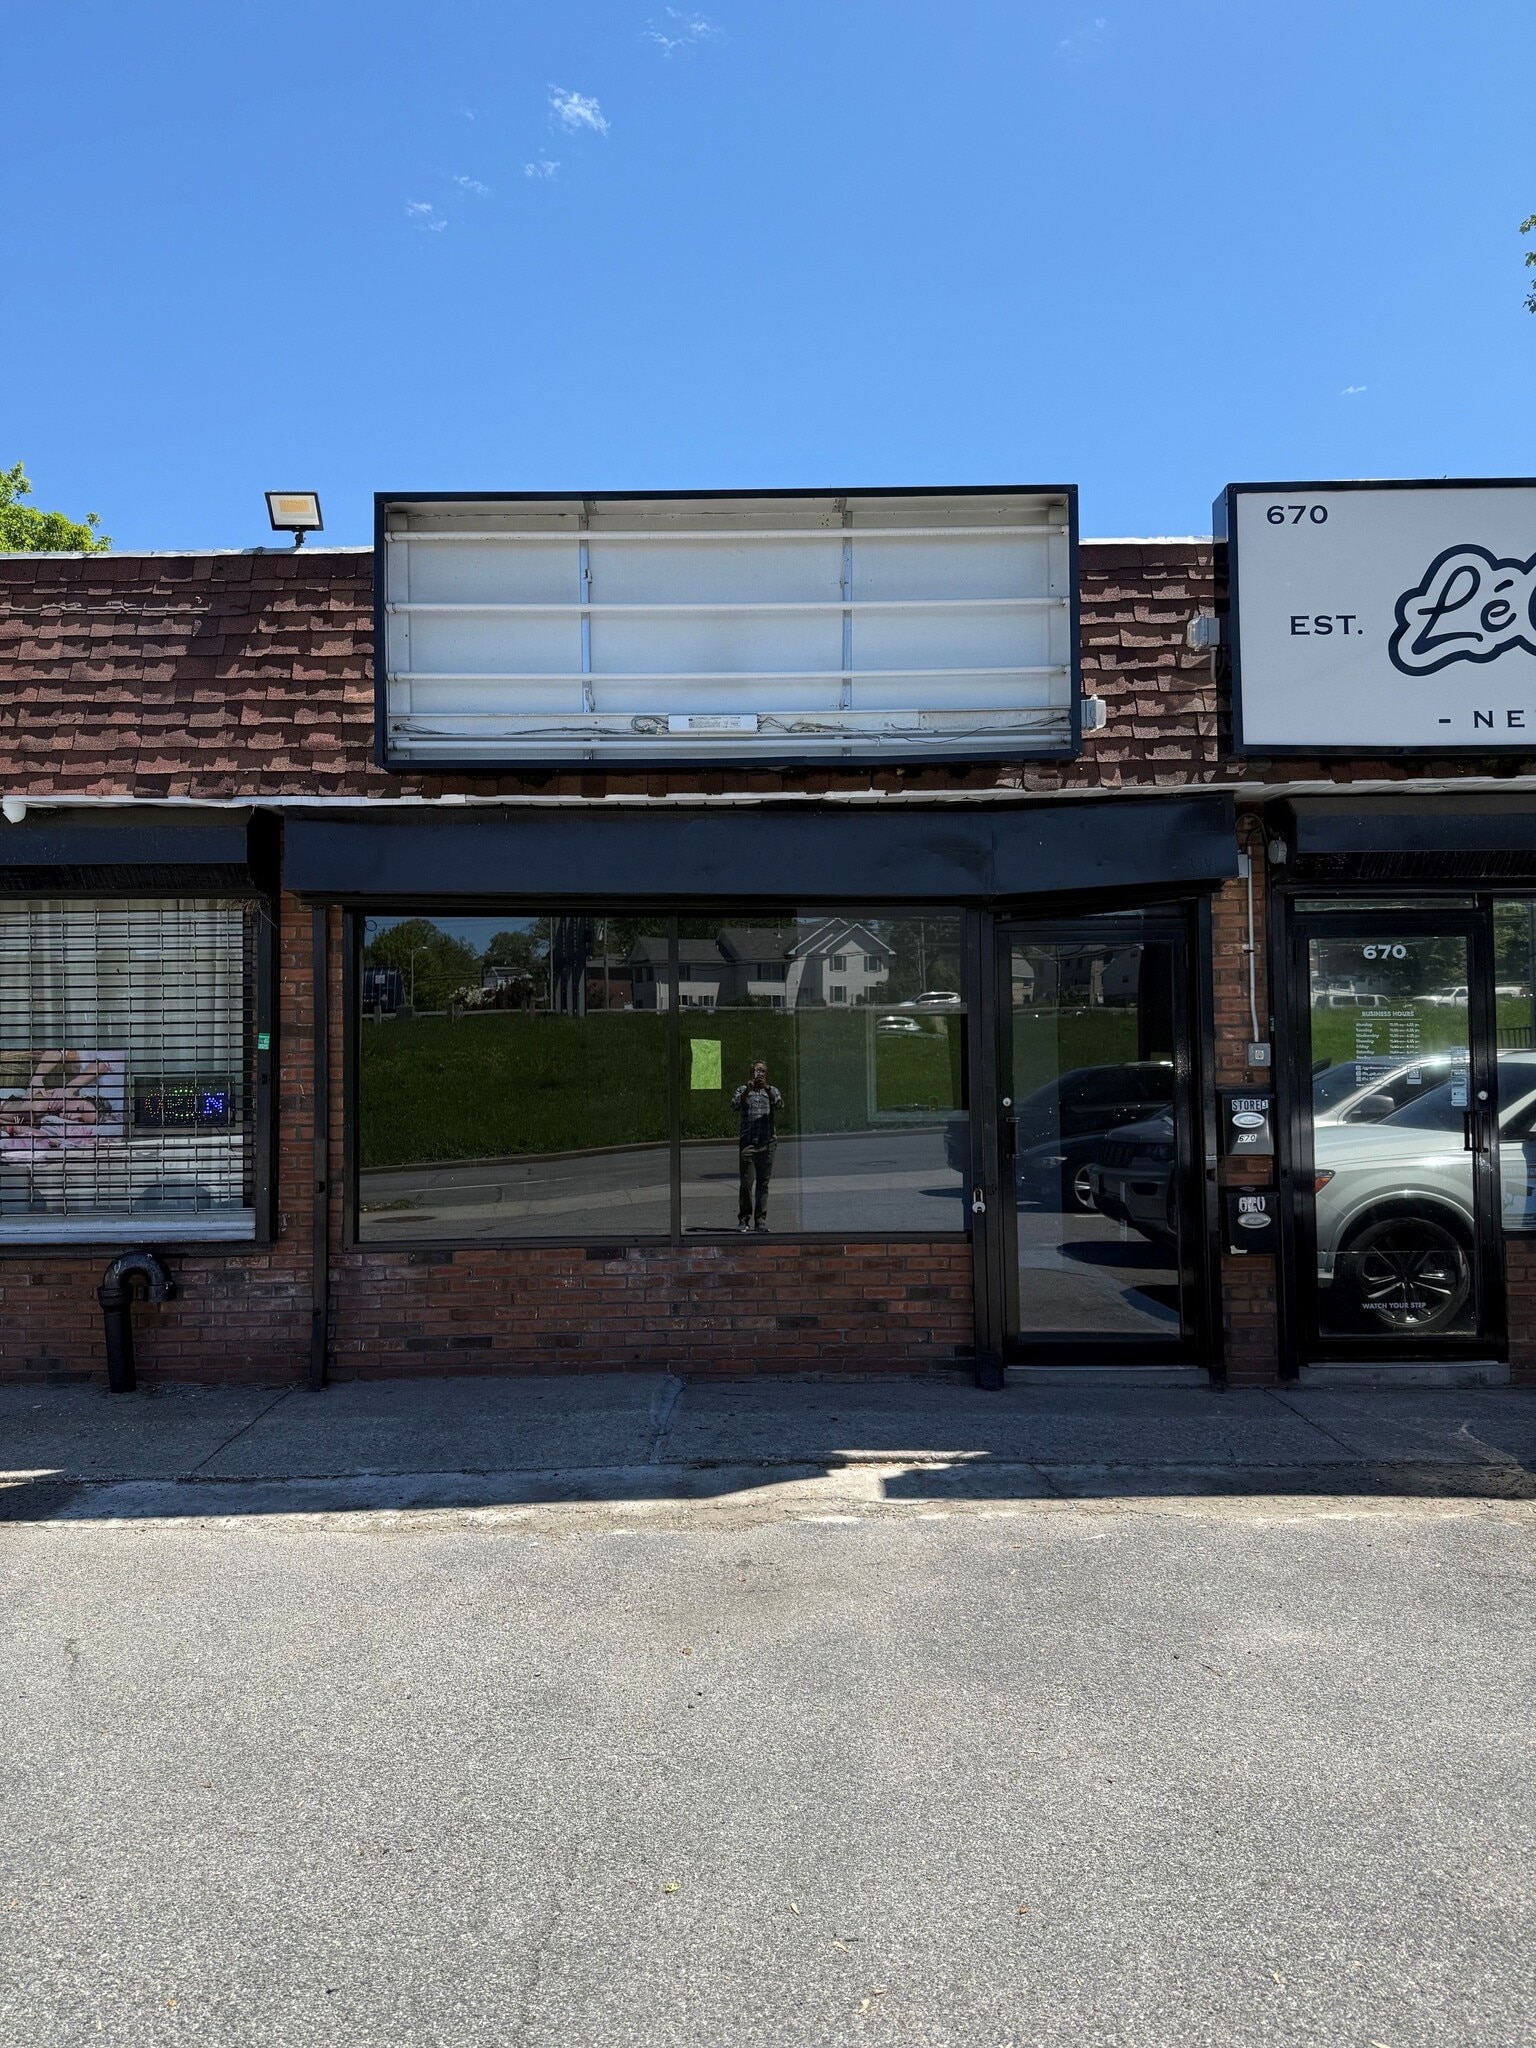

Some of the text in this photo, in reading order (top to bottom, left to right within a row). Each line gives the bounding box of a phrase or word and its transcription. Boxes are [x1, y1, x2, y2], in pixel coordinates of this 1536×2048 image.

[1266, 505, 1328, 525] 670
[1290, 615, 1363, 635] EST.
[1473, 710, 1536, 728] NE
[1363, 944, 1407, 960] 670
[144, 1092, 225, 1115] OPEN
[1232, 1100, 1260, 1110] STORE
